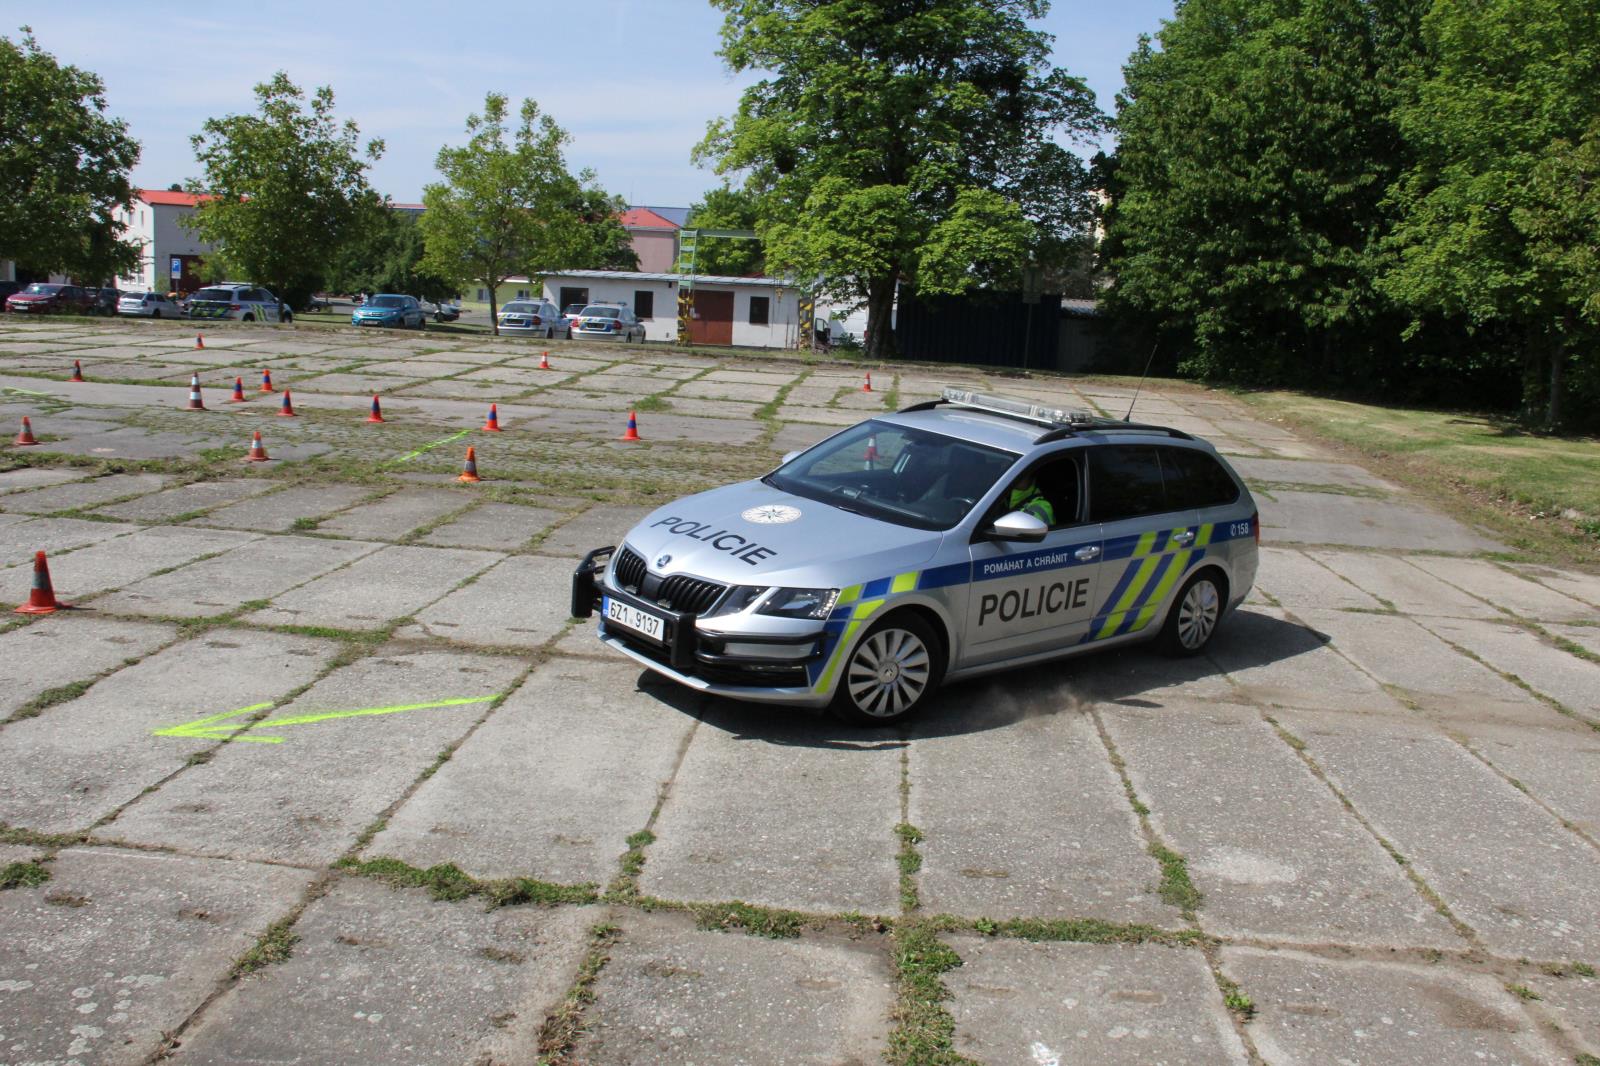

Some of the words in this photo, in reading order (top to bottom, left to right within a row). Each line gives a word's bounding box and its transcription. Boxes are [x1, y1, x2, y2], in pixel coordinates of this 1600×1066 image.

[650, 516, 778, 566] POLICIE
[1237, 522, 1249, 535] 158
[984, 559, 1024, 574] POMÁHAT
[1026, 558, 1033, 568] A
[1034, 552, 1068, 566] CHRÁNIT
[610, 602, 628, 623] 6Z1
[635, 612, 659, 635] 9137
[978, 578, 1090, 627] POLICIE
